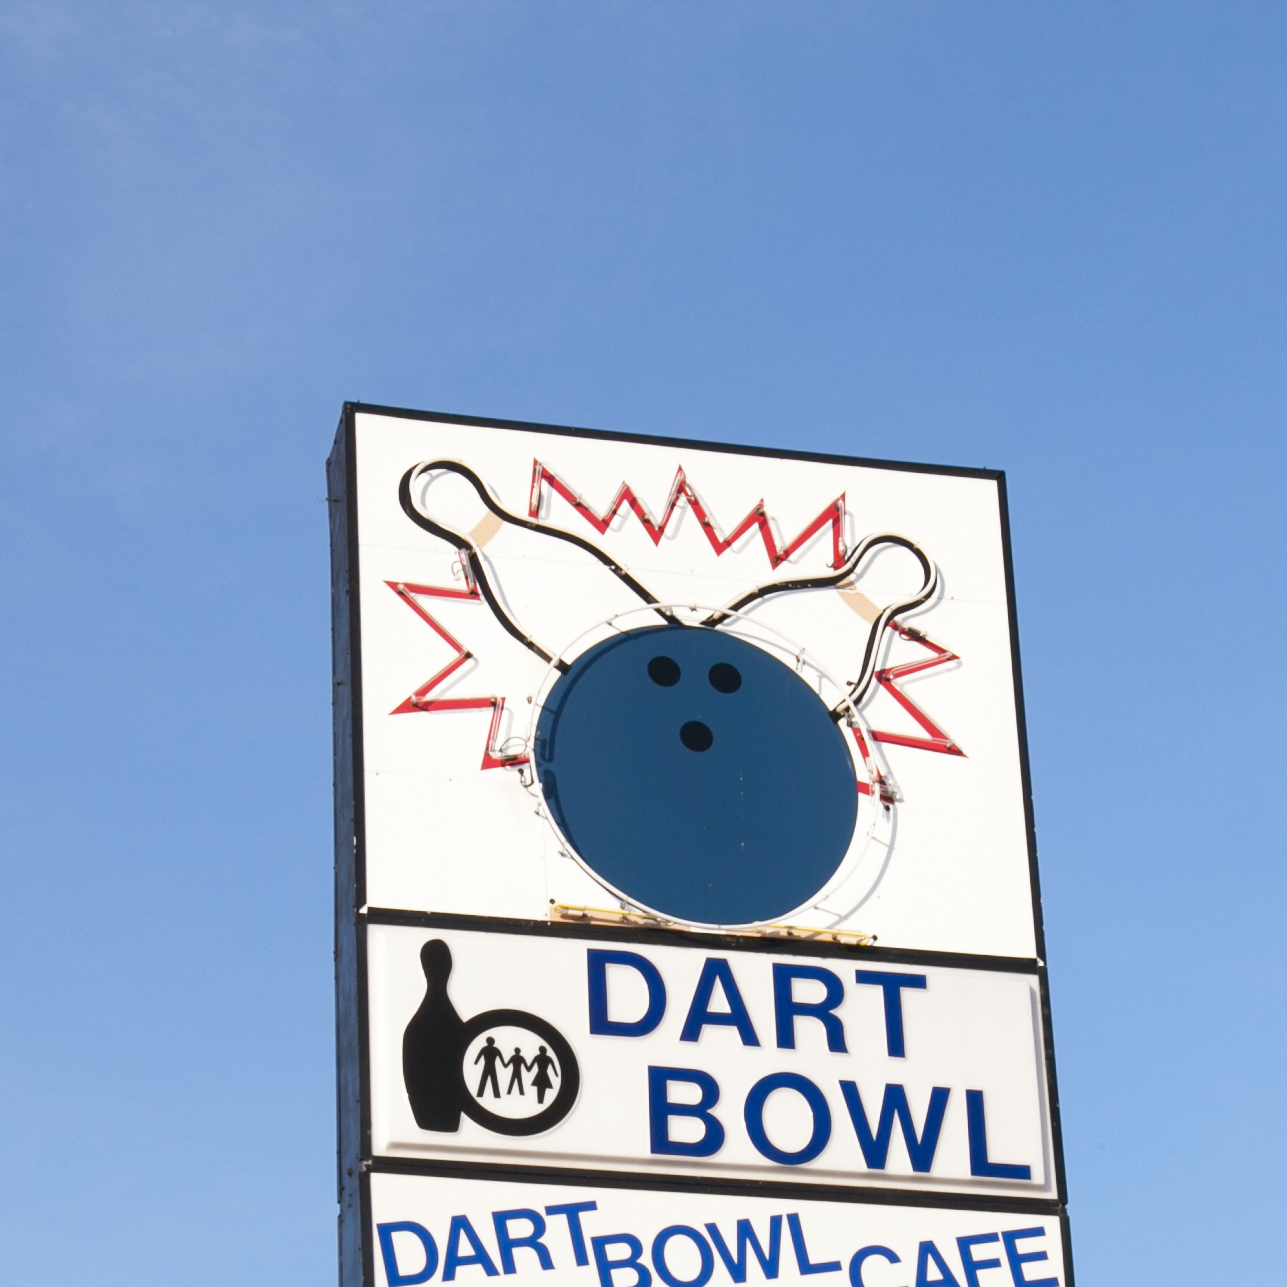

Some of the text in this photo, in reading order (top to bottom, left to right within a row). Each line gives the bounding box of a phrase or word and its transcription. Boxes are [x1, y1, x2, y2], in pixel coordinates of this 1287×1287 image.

[588, 949, 926, 1057] DART
[648, 1066, 1031, 1180] BOWL
[377, 1202, 597, 1287] DART
